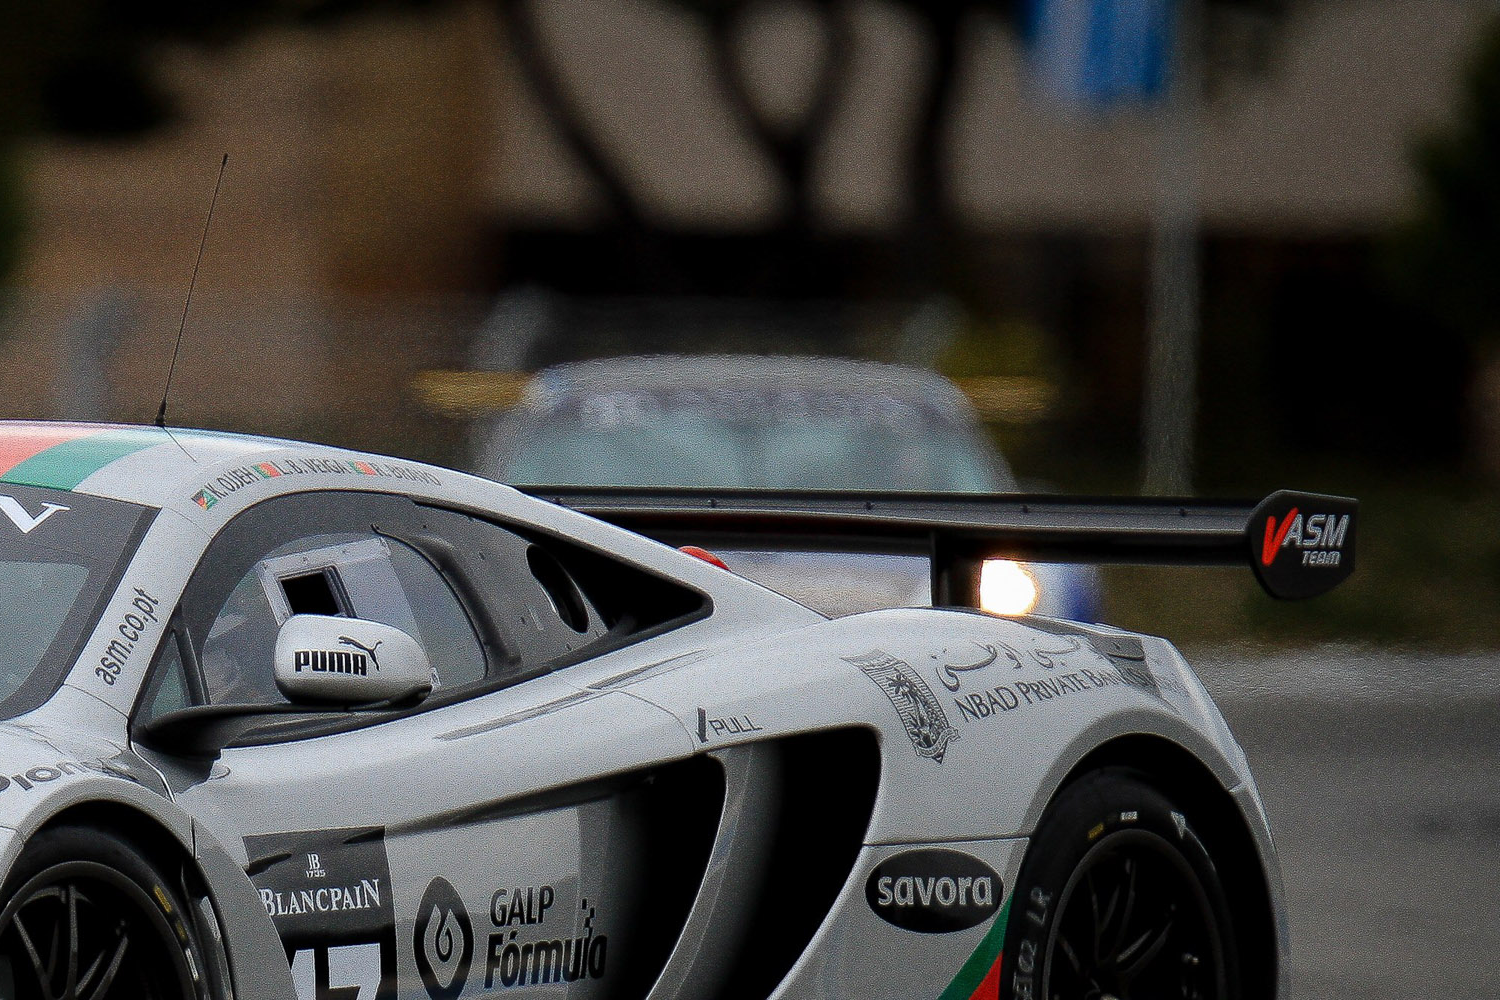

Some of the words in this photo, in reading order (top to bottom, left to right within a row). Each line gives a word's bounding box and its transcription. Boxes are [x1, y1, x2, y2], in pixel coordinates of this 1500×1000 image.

[1302, 551, 1341, 565] TEAM
[95, 587, 160, 686] asm.co.pt
[295, 650, 367, 676] PUMA
[954, 685, 1019, 723] NBAD
[1015, 669, 1091, 705] PRIVATE
[708, 715, 763, 736] PULL
[259, 879, 381, 917] BLANCPAIN
[490, 885, 555, 927] GALP
[878, 876, 993, 906] savora
[484, 929, 608, 989] Fórmula
